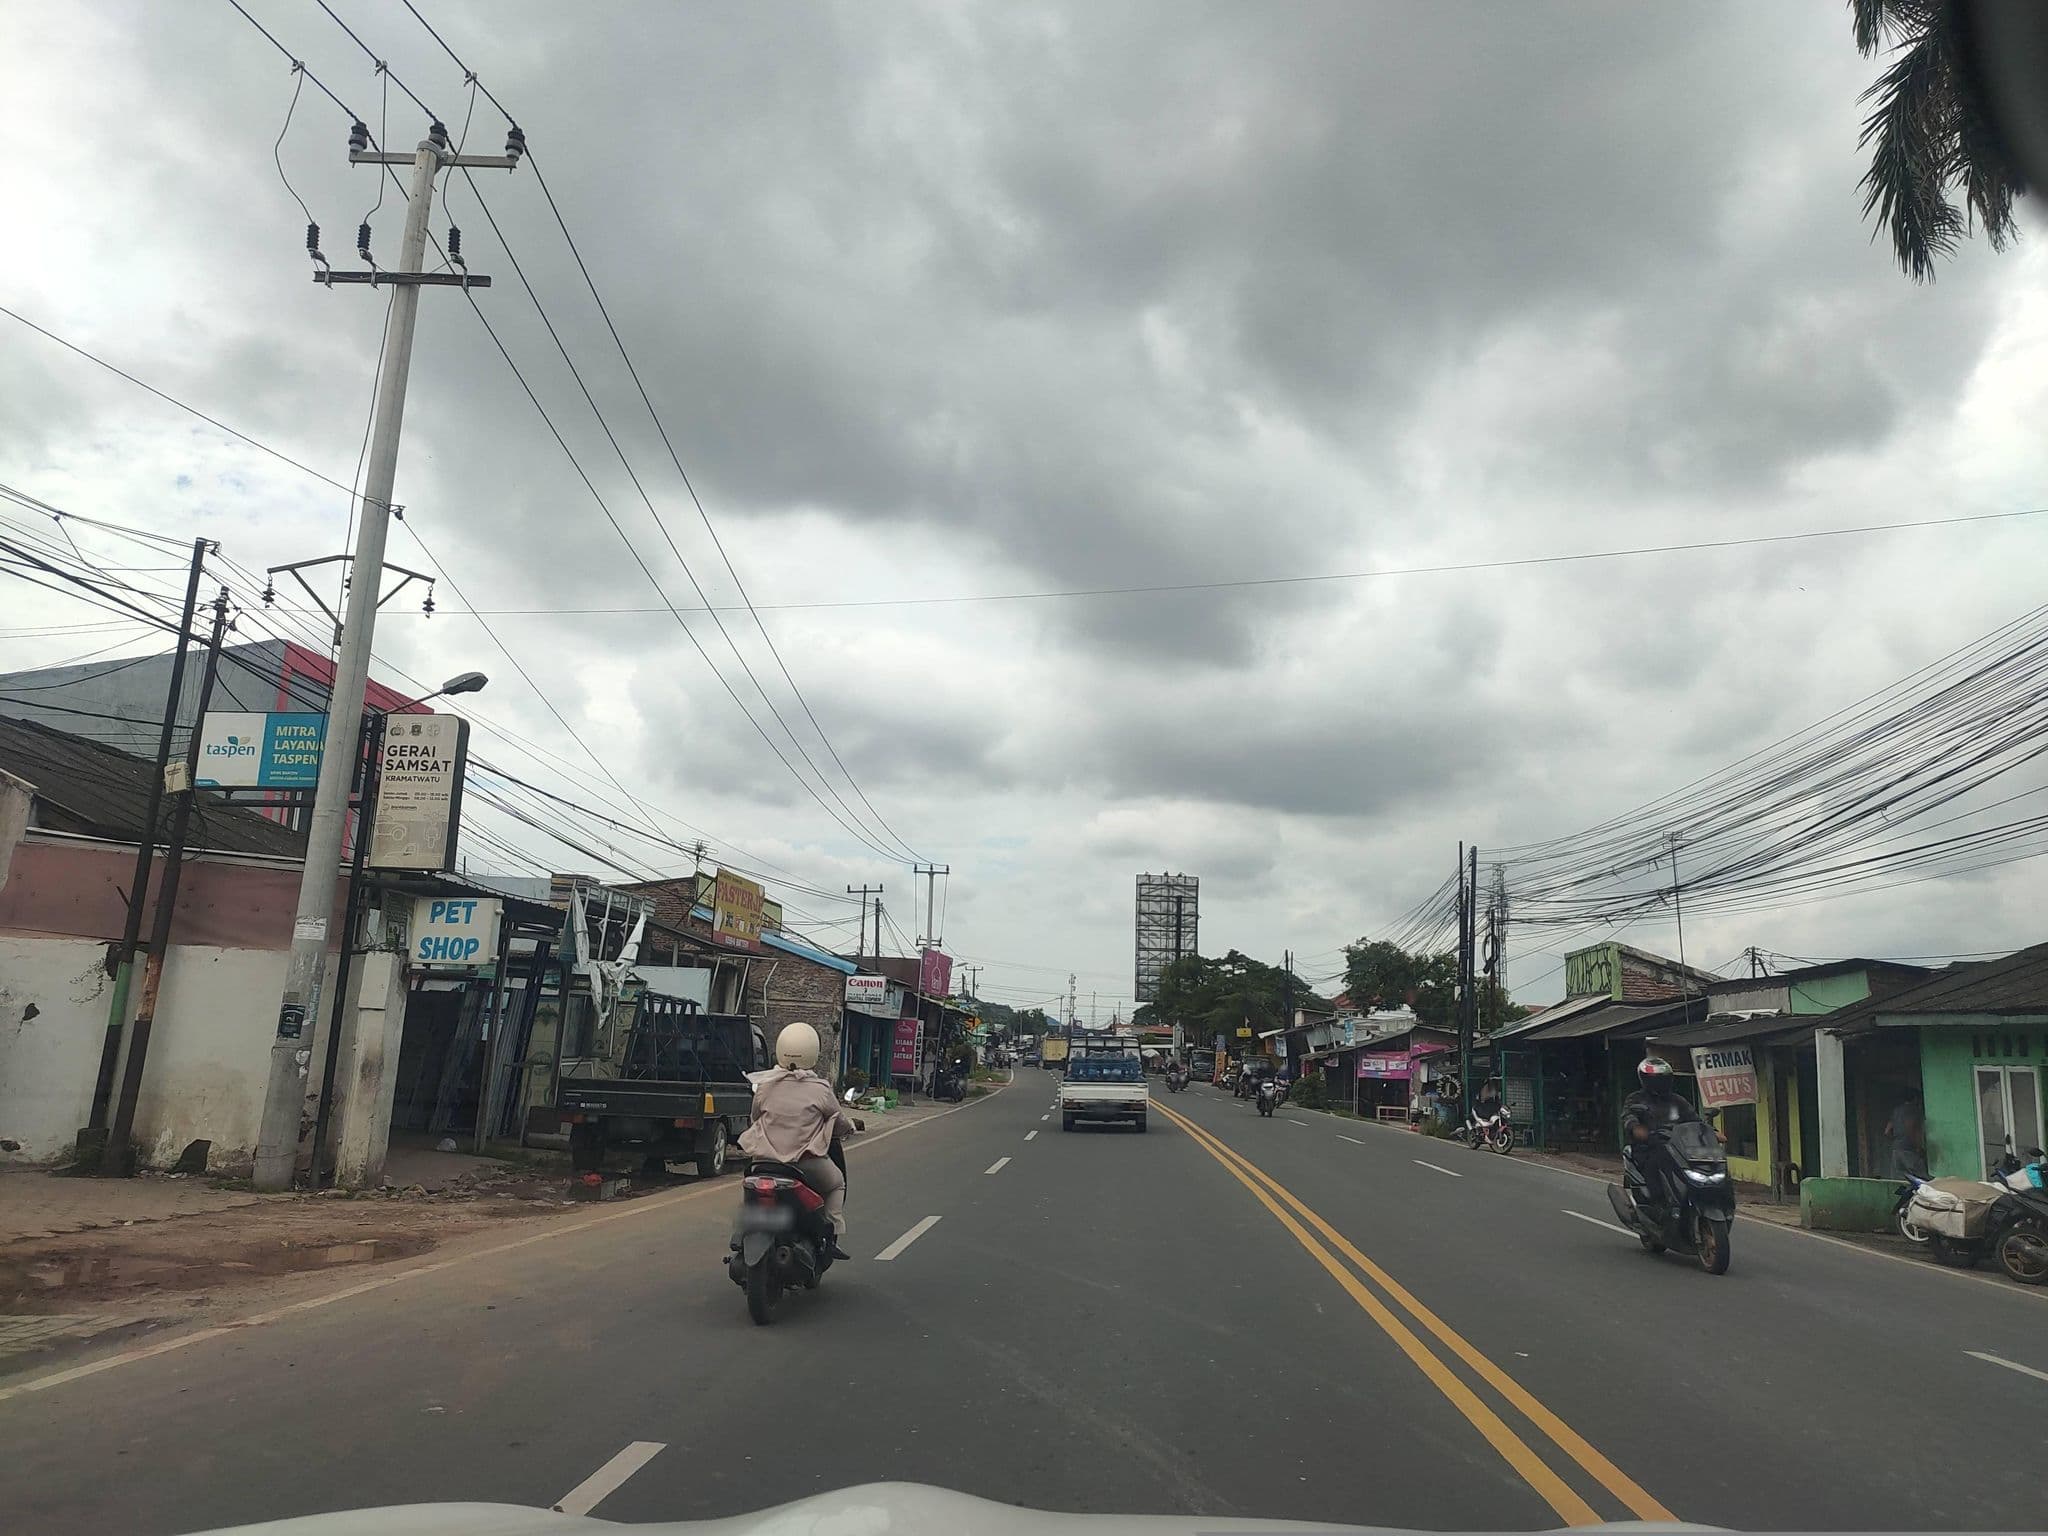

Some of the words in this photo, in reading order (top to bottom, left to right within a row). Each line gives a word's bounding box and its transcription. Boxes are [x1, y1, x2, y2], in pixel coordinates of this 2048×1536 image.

[276, 726, 316, 737] MITRA
[206, 744, 256, 758] taspen
[274, 740, 325, 751] LAYANA
[387, 745, 436, 758] GERAI
[272, 753, 318, 765] TASPEN
[385, 759, 452, 772] SAMSAT
[385, 775, 441, 783] KRAMATWATU
[429, 901, 478, 924] PET
[418, 937, 480, 960] SHOP
[848, 978, 883, 988] Canon
[1706, 1077, 1752, 1097] LEVI'S
